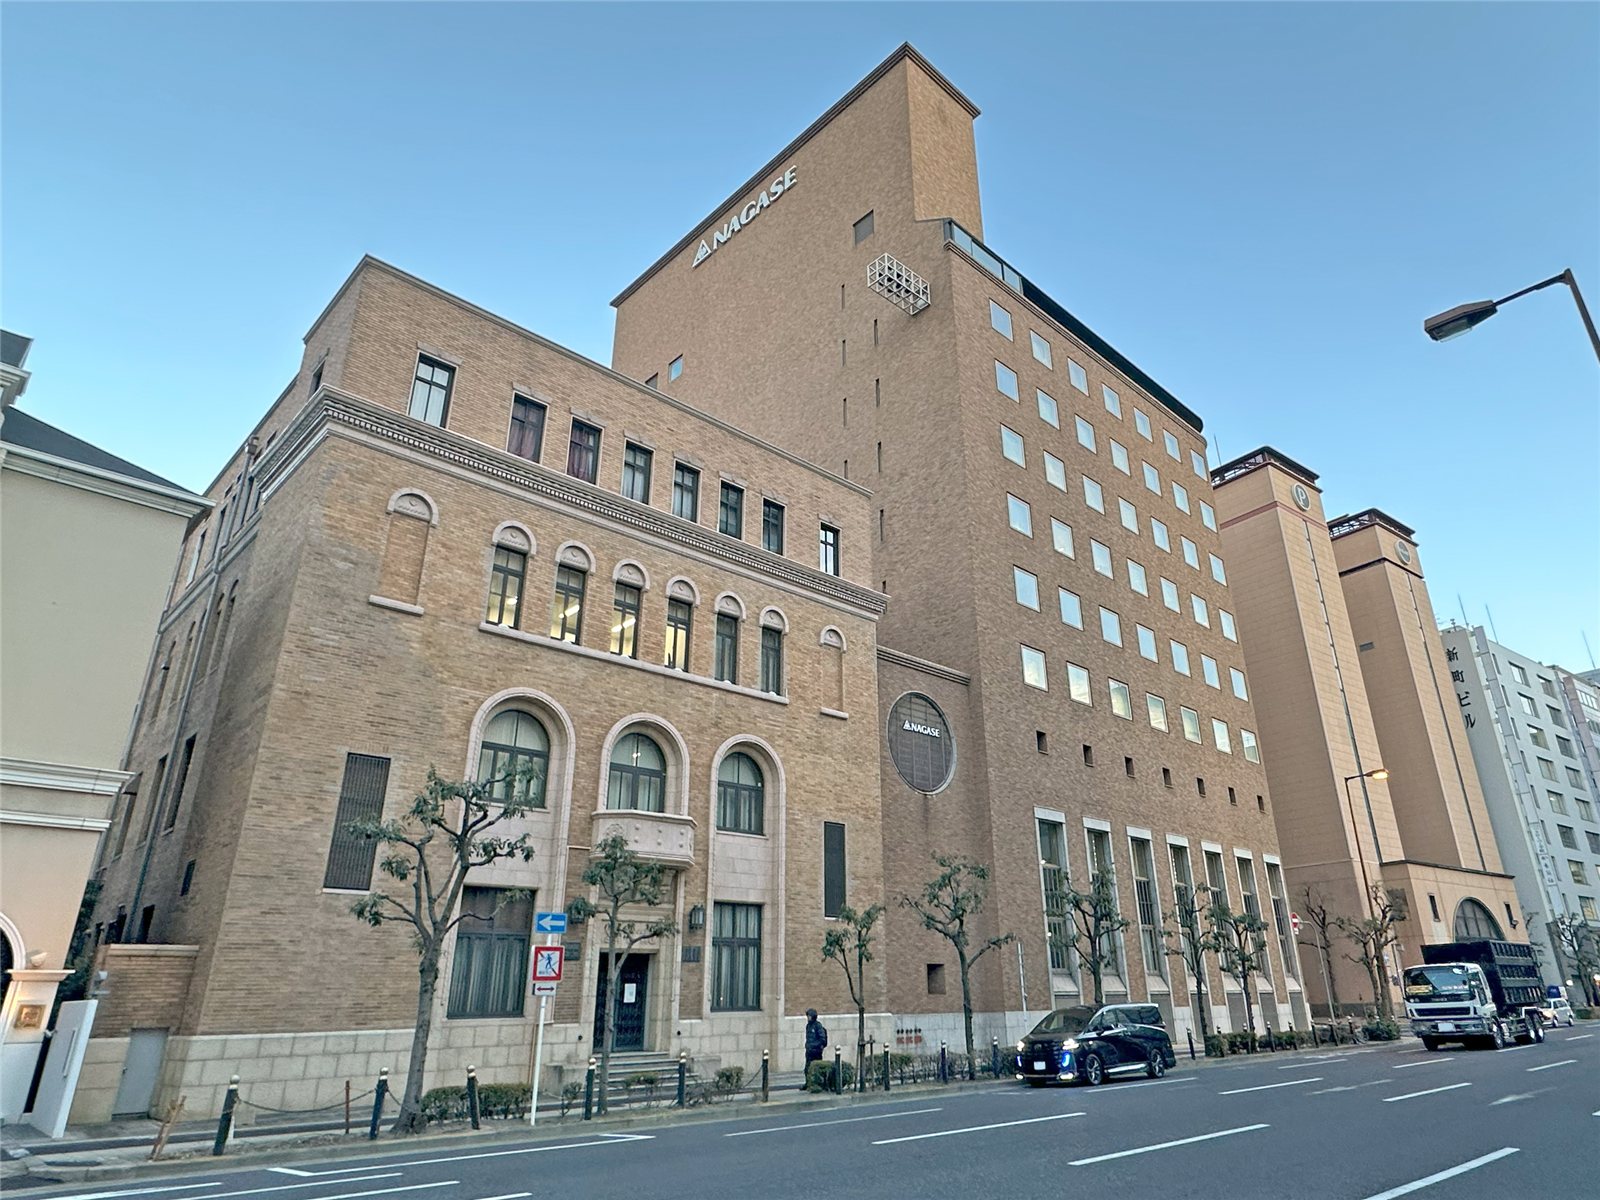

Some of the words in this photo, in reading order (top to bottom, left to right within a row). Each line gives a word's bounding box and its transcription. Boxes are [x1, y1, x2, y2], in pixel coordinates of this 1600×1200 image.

[712, 164, 797, 251] NAGASE
[1446, 646, 1476, 729] 新町ビル
[910, 722, 941, 738] NAGASE
